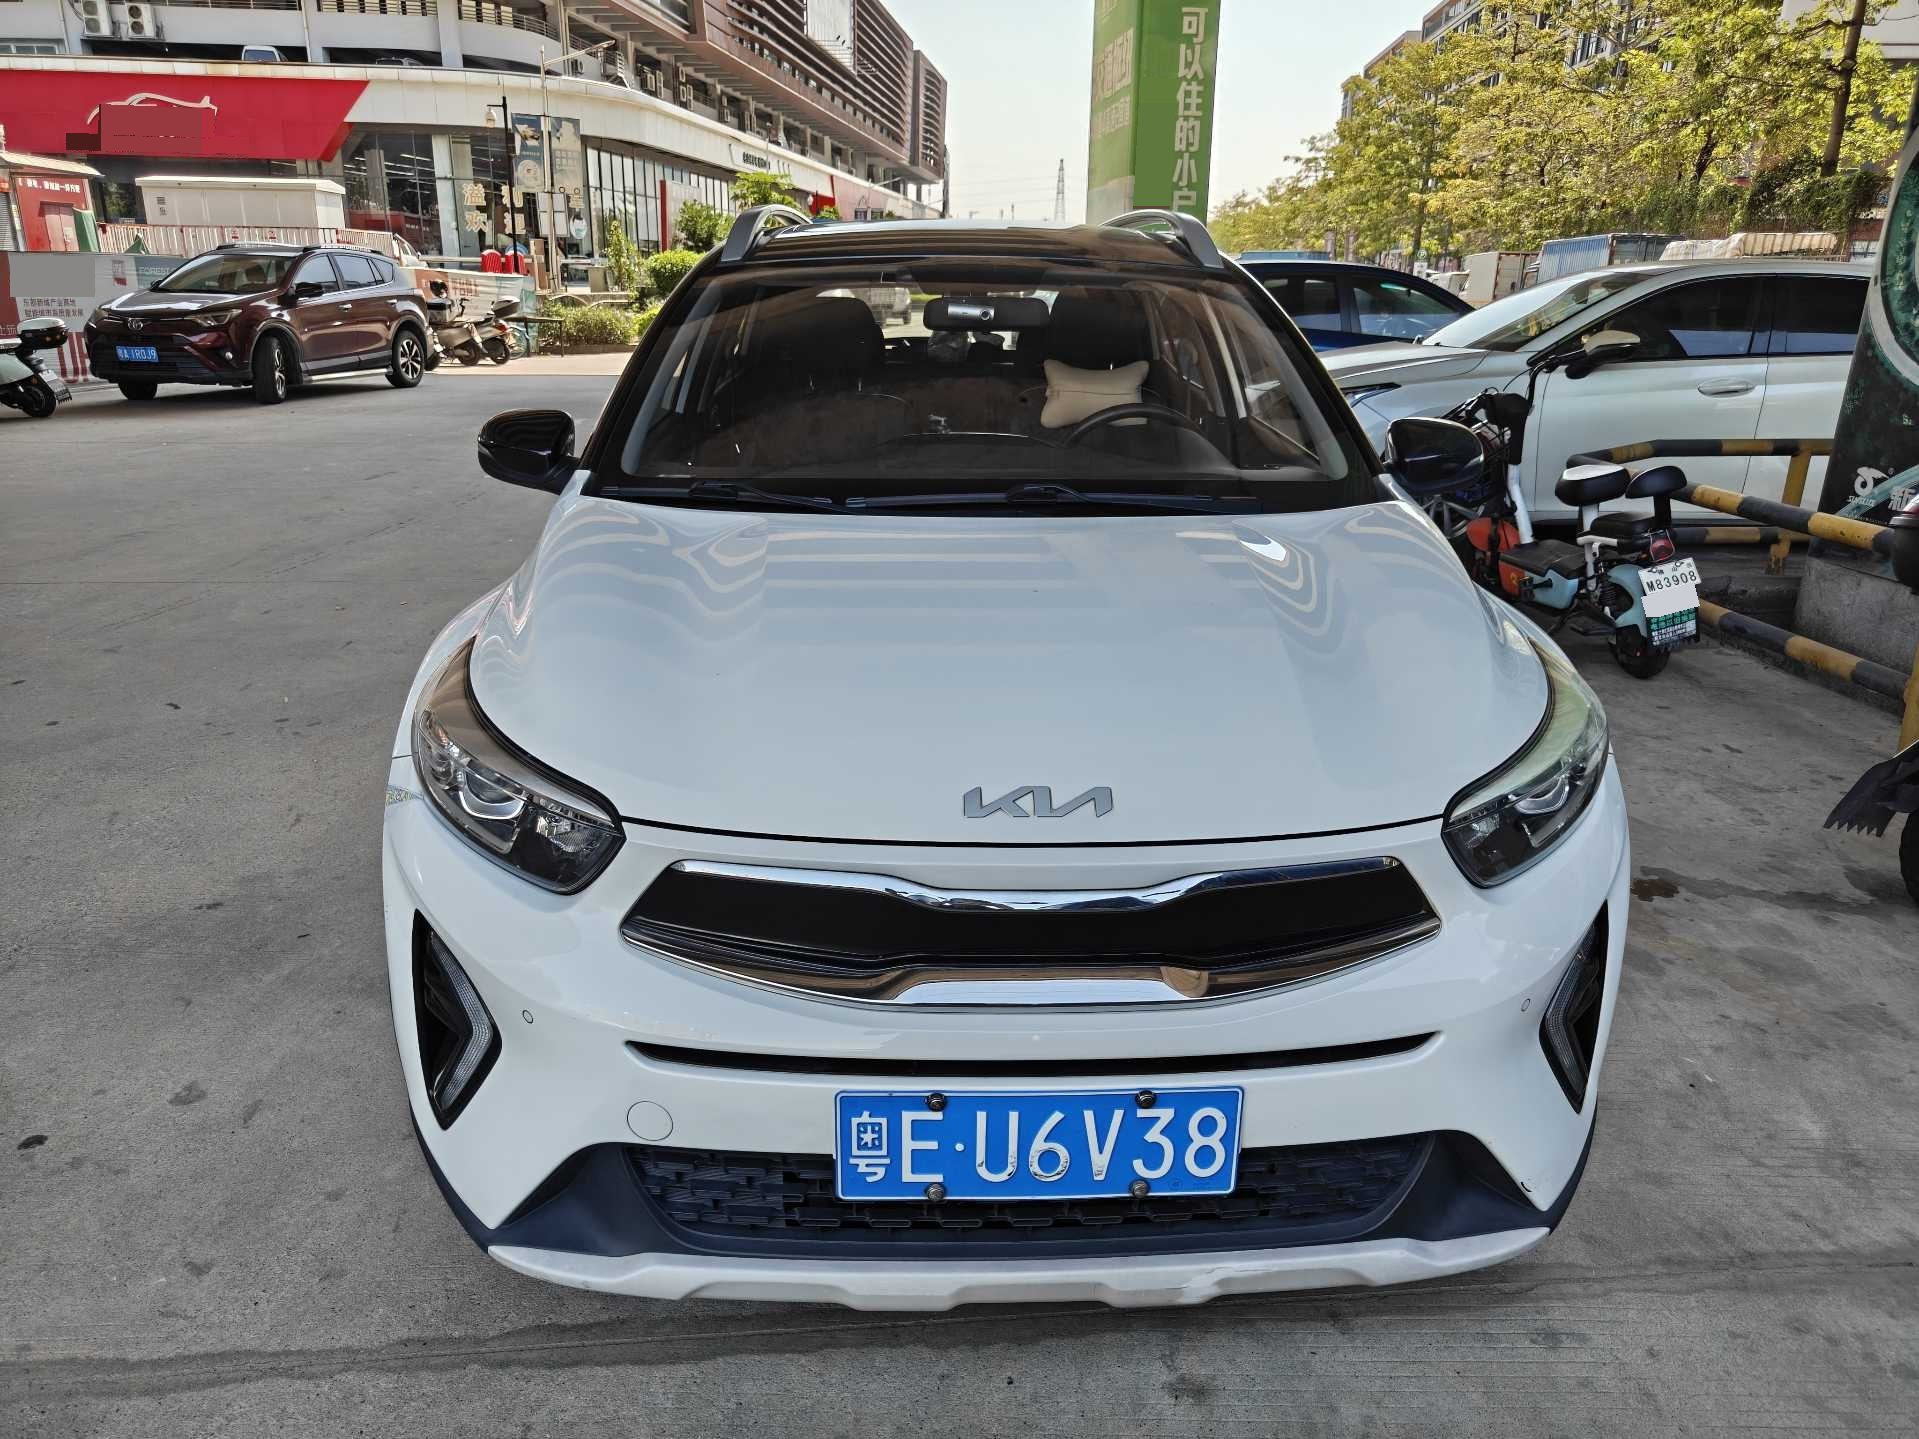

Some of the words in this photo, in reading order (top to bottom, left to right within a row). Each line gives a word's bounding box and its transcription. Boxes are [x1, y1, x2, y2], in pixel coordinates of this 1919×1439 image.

[1172, 7, 1209, 212] 可以住的小户
[1646, 570, 1697, 592] M83908
[963, 785, 1113, 818] KIA
